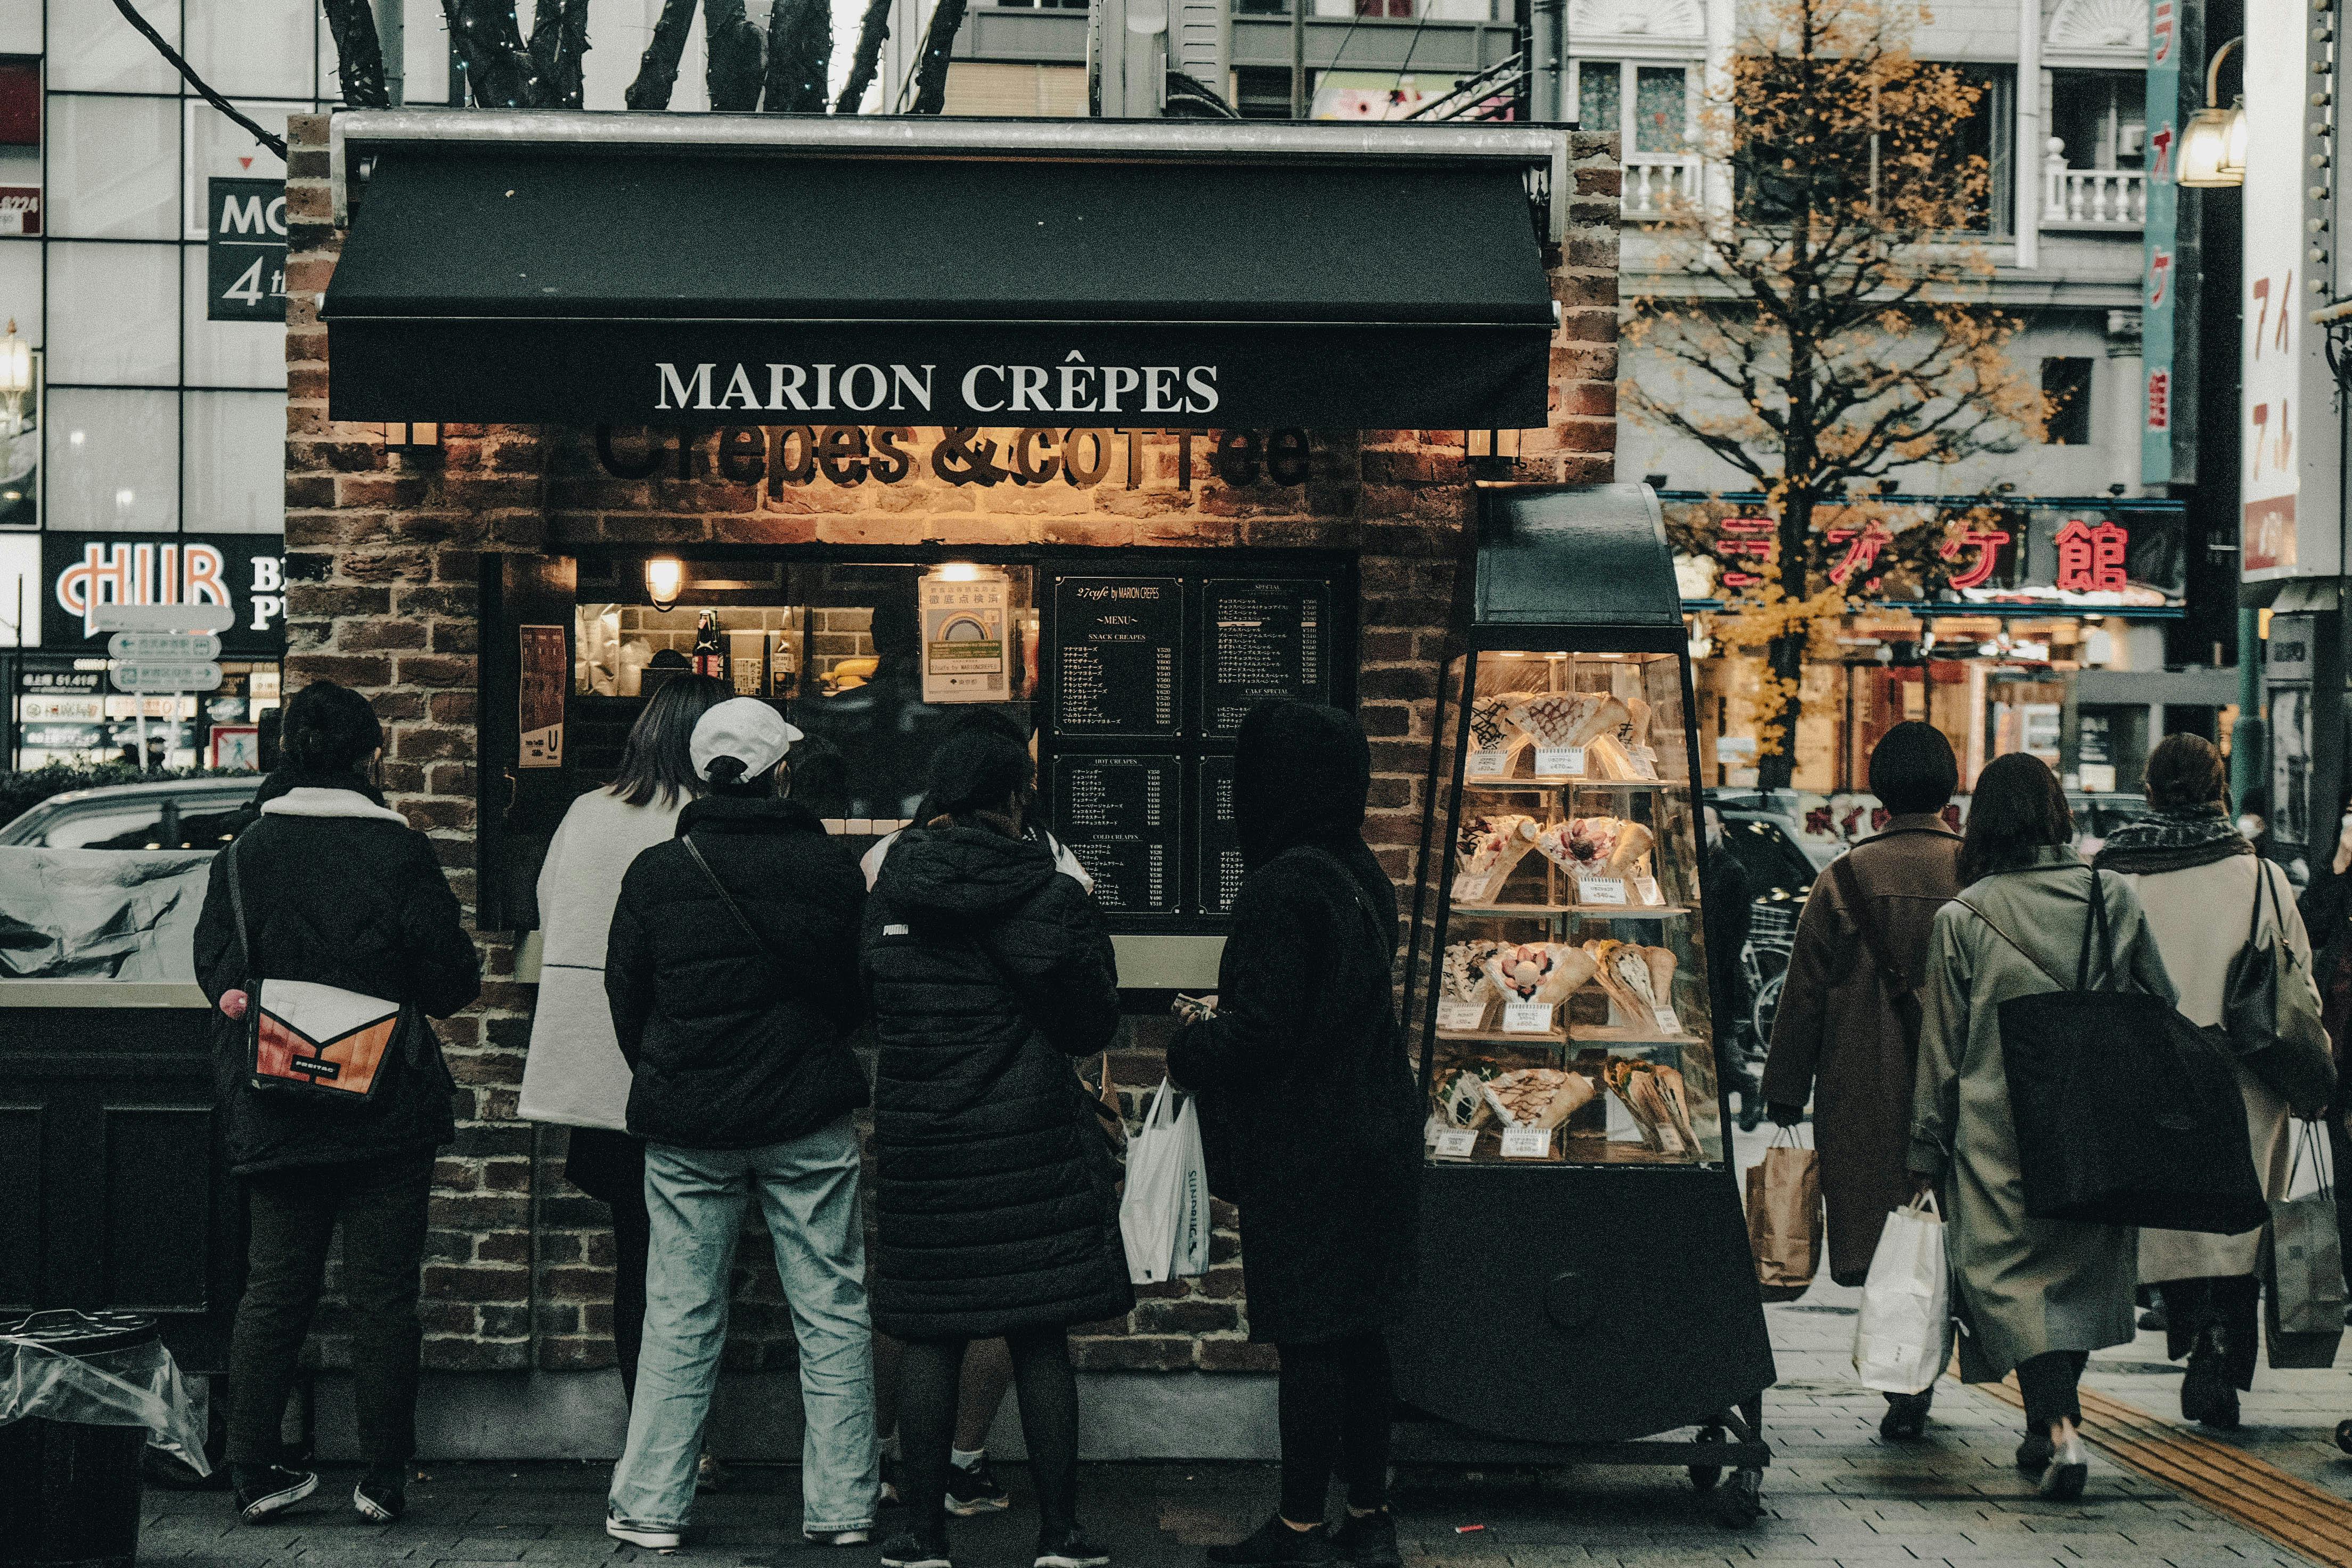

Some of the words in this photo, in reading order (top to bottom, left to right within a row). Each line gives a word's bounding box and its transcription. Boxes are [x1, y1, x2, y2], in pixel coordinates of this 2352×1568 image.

[655, 363, 936, 411] MARION
[961, 350, 1219, 413] CRÊPES
[929, 594, 999, 604] 徹底点検済
[1111, 586, 1118, 601] by
[1118, 587, 1140, 599] MARION
[1140, 587, 1159, 599] CREPES
[296, 1060, 334, 1073] FREITAG
